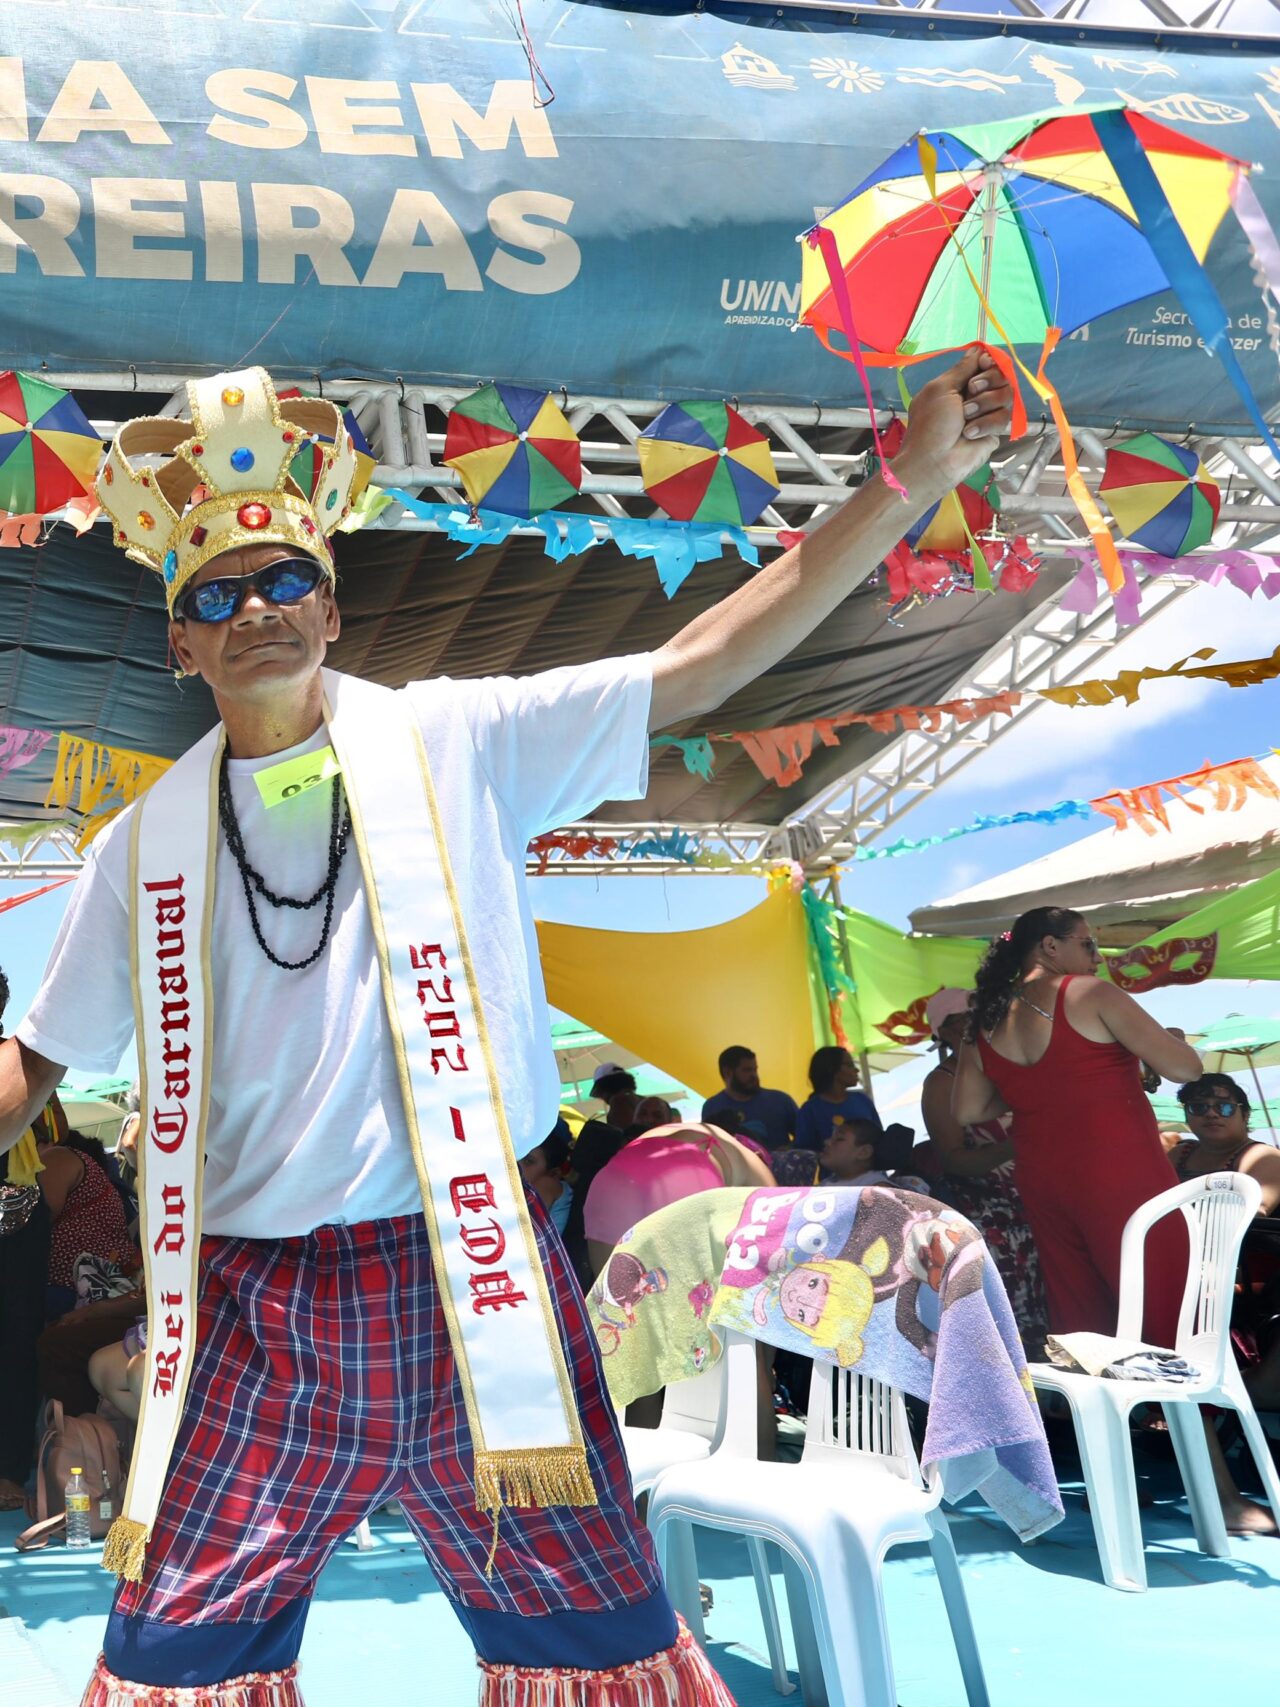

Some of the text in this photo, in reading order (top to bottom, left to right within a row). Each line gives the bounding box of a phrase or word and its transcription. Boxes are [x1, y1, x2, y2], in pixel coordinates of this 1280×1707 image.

[204, 68, 560, 160] SEM
[1124, 327, 1192, 348] Turismo
[1229, 337, 1263, 351] zer
[1152, 306, 1262, 329] Secra de
[409, 942, 469, 1075] 2025
[141, 873, 192, 1398] Rei do Carnaval
[449, 1172, 529, 1316] PCD
